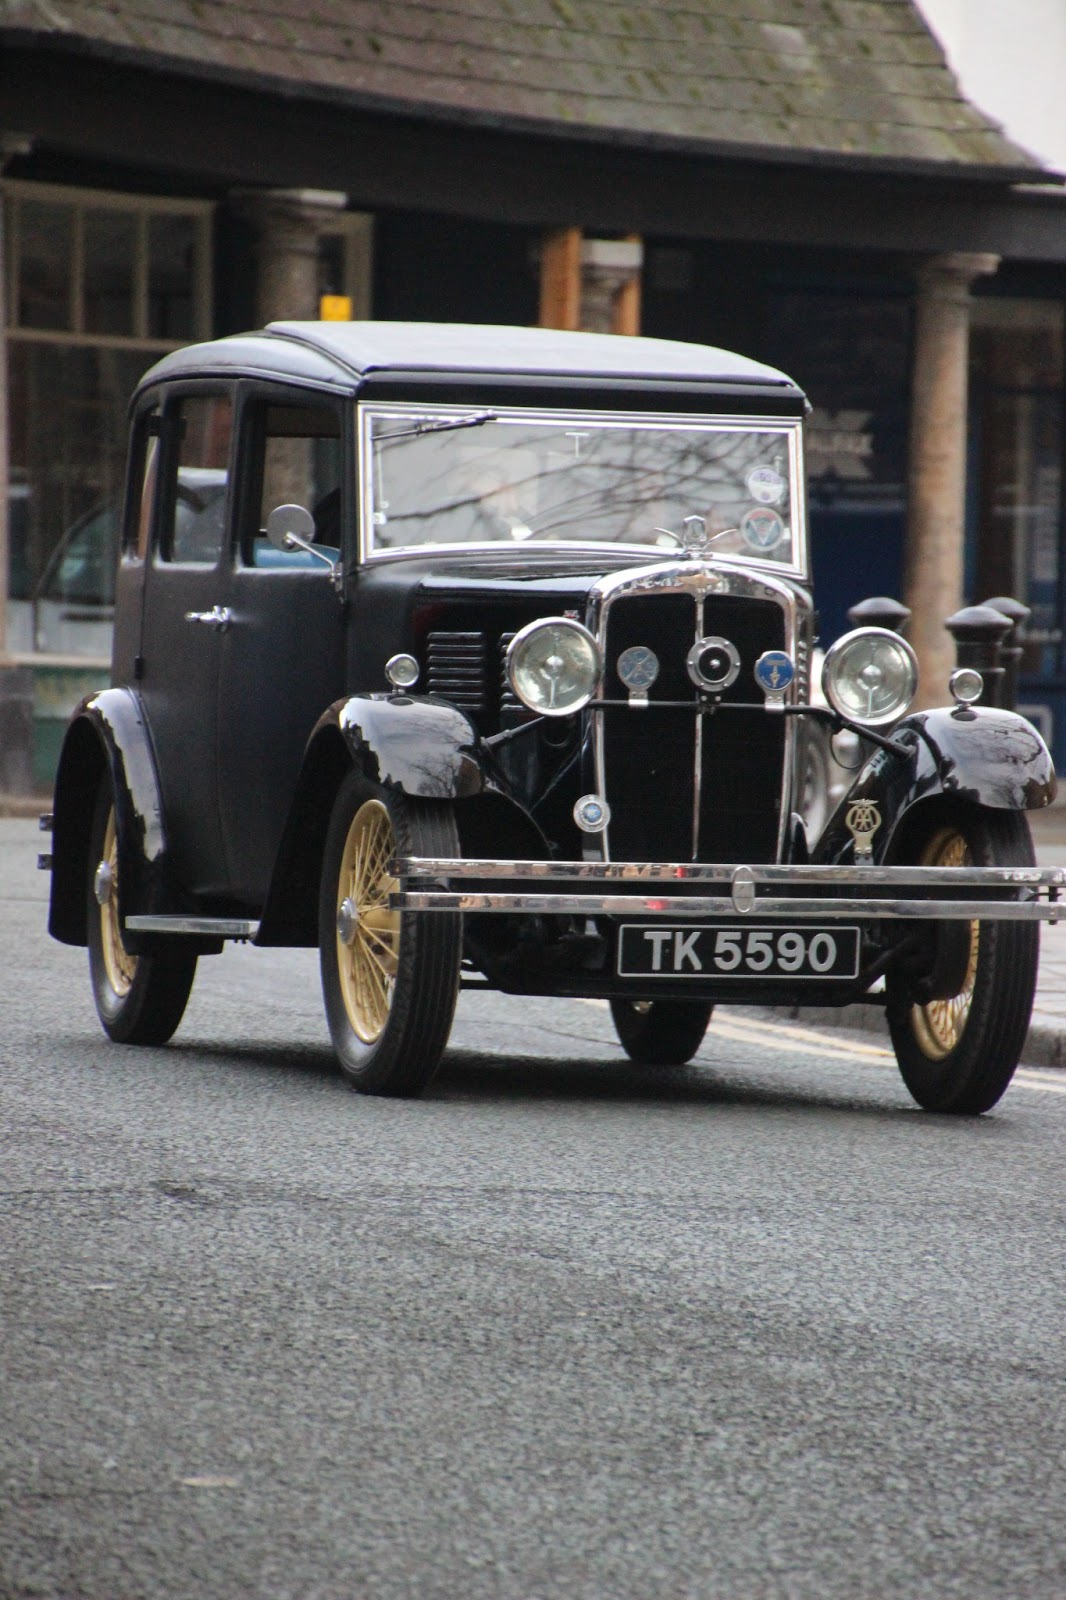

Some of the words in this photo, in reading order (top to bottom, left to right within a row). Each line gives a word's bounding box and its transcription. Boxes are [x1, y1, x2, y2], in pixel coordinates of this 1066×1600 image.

[852, 807, 876, 832] AA
[643, 931, 703, 971] TK
[713, 931, 837, 972] 5590
